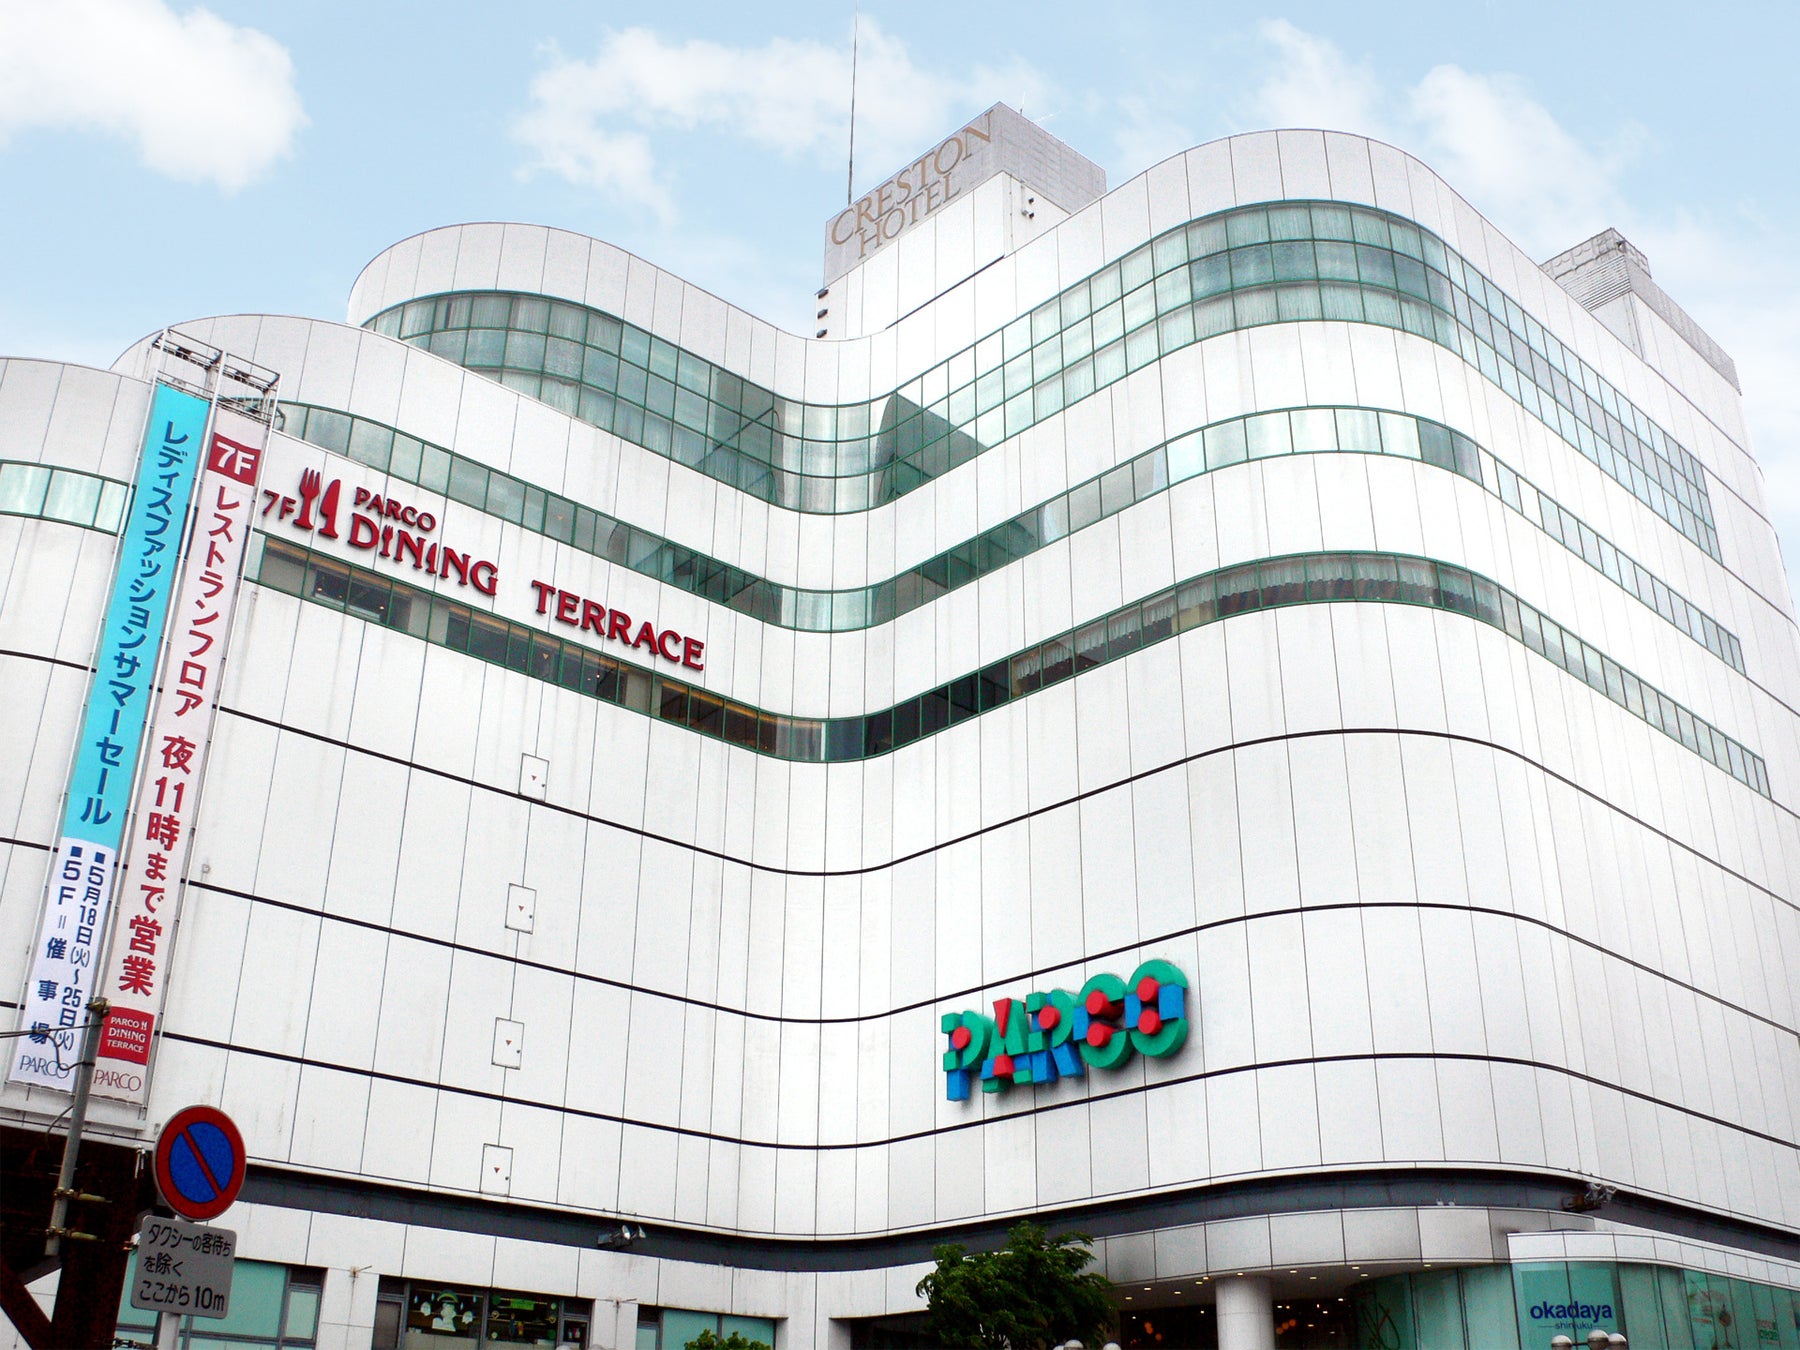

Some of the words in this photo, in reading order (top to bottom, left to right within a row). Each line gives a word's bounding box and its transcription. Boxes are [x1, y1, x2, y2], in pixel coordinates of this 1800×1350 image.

[831, 109, 994, 246] CRESTON
[858, 172, 961, 260] HOTEL
[217, 447, 255, 475] 7F
[263, 489, 297, 520] 7F
[354, 486, 437, 533] PARCO
[174, 485, 240, 717] レストランフロア
[347, 512, 499, 596] DINING
[532, 580, 705, 671] TERRACE
[80, 420, 189, 826] レディスファッションサマーセール
[108, 1027, 147, 1044] DINING
[110, 1016, 139, 1029] PARCO
[941, 958, 1189, 1102] PARCO
[107, 1039, 145, 1054] TERRACE
[19, 1055, 70, 1080] PARCO
[93, 1069, 142, 1092] PARCO
[148, 1223, 232, 1257] タクシーの客待ち
[143, 1252, 184, 1277] を除く
[1529, 1301, 1613, 1323] okadaya
